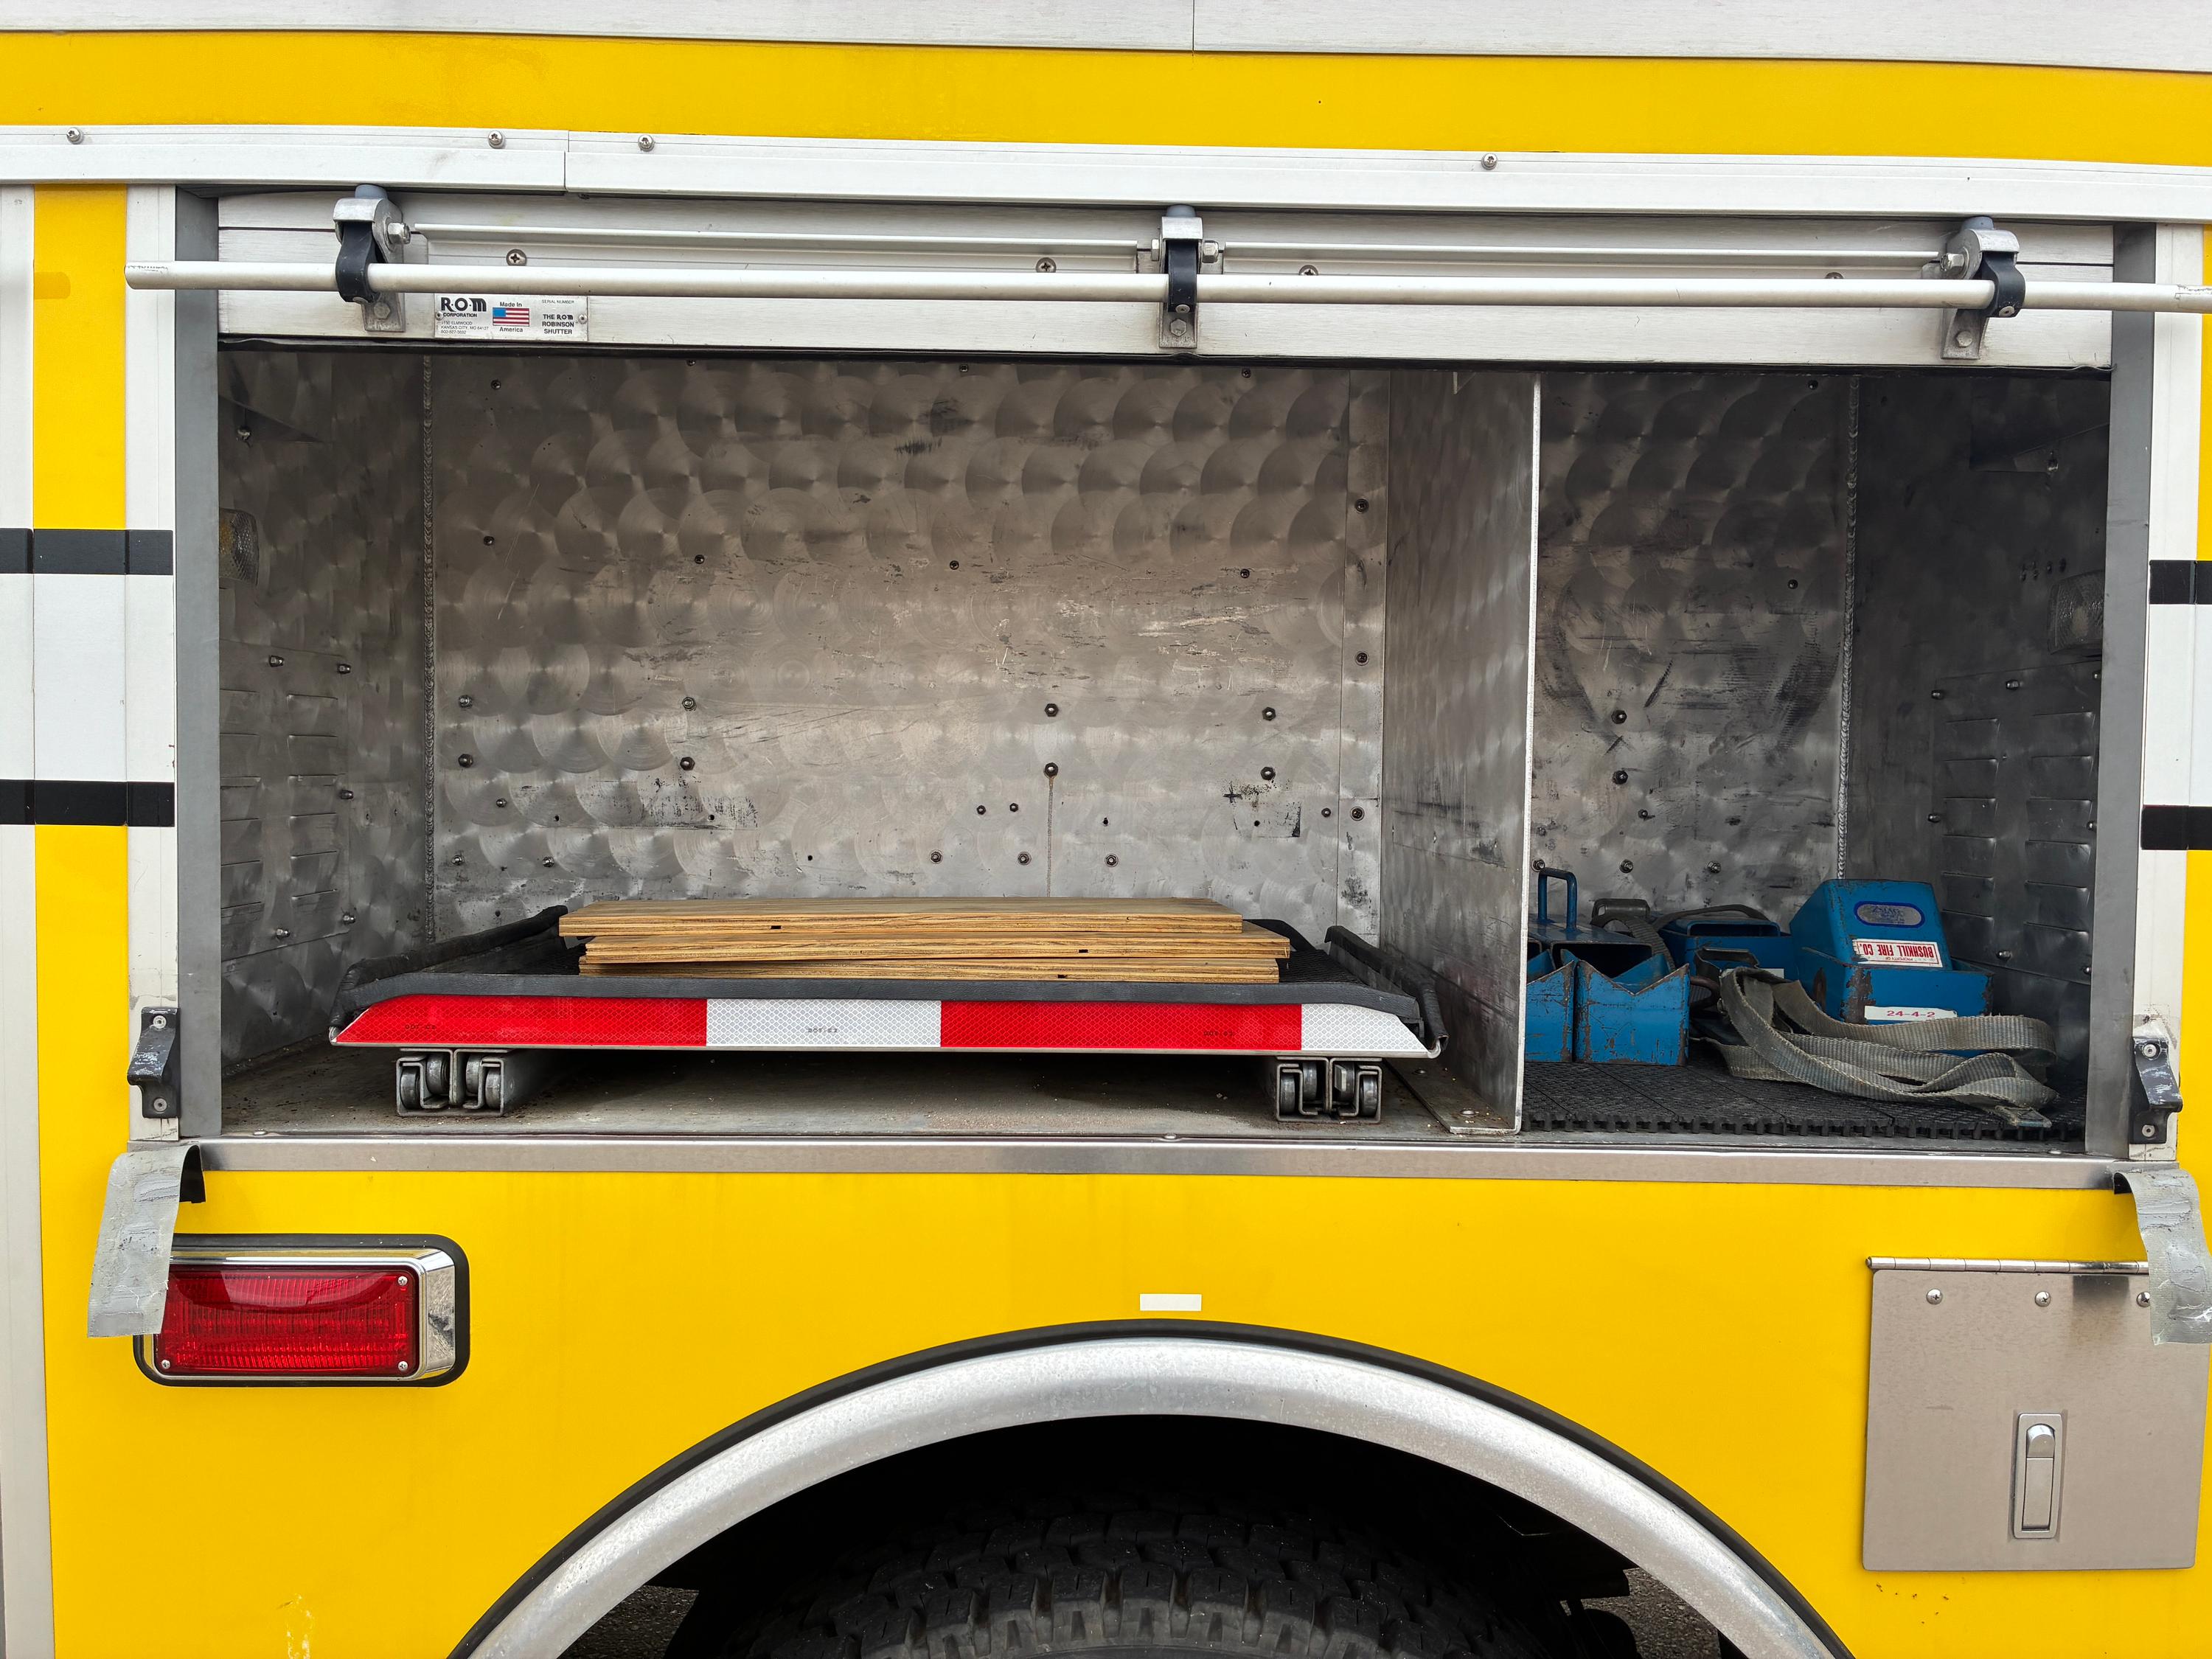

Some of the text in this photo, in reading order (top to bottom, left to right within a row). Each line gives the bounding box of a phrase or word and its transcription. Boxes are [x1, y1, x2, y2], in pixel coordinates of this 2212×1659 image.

[1860, 944, 1934, 958] BUSHKILL FIRE CO.
